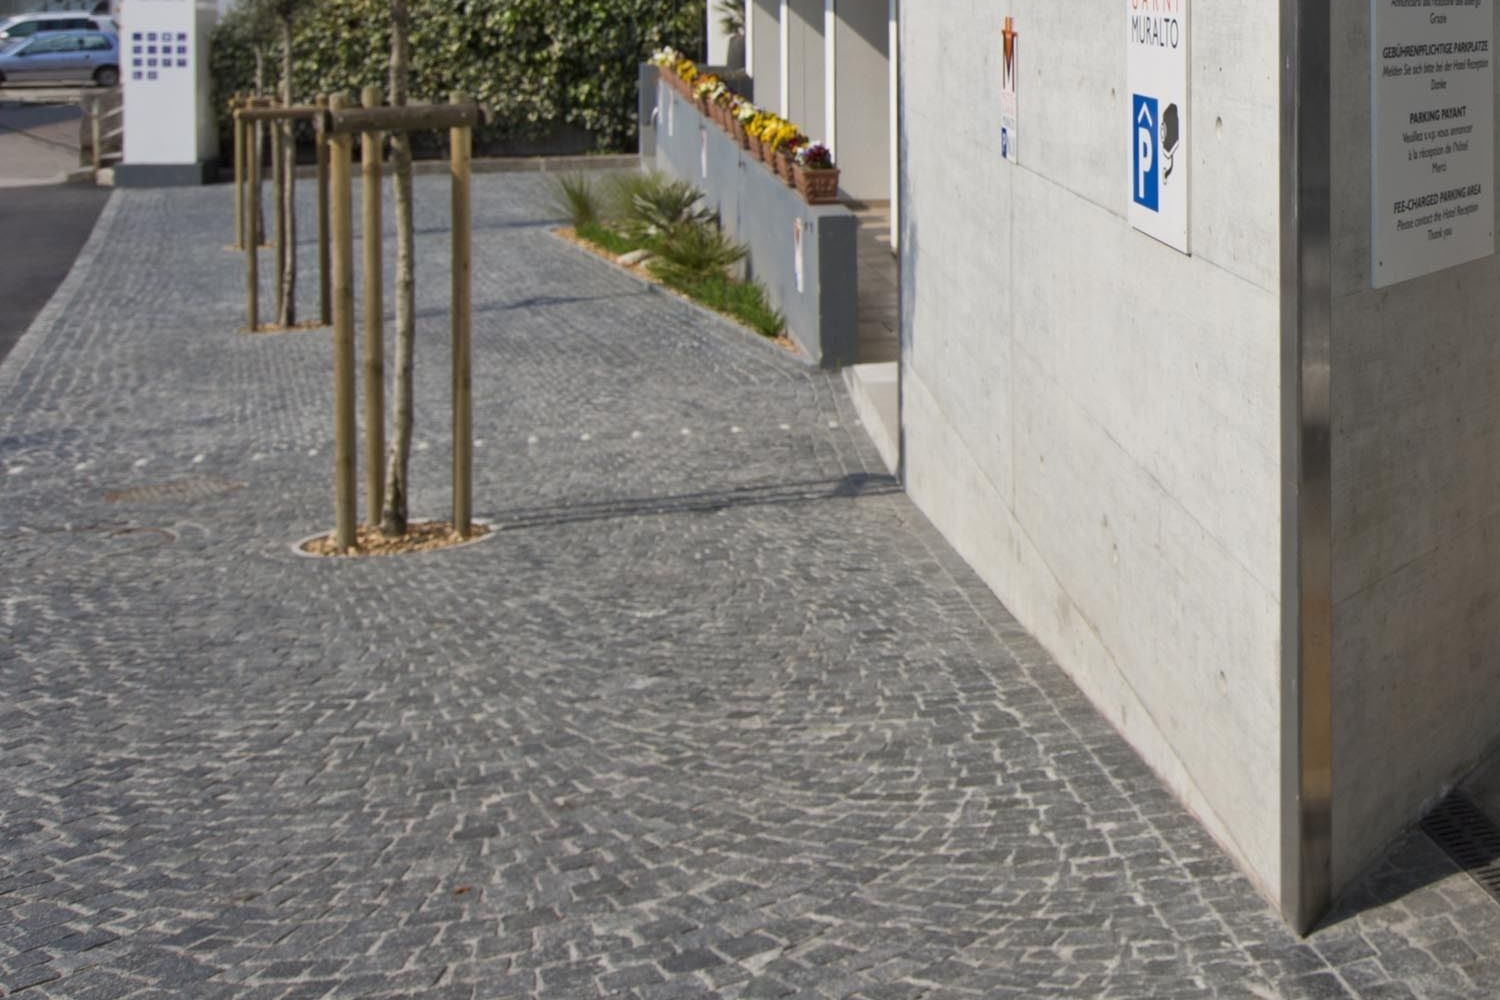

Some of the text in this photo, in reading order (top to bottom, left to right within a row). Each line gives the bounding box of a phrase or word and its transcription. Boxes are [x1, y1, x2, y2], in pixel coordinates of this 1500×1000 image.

[1131, 15, 1179, 49] MURALTO
[1409, 106, 1466, 124] PARKING PAYANT
[1139, 126, 1153, 199] P
[1393, 184, 1481, 214] FEE-CHARGED PARKING AREA
